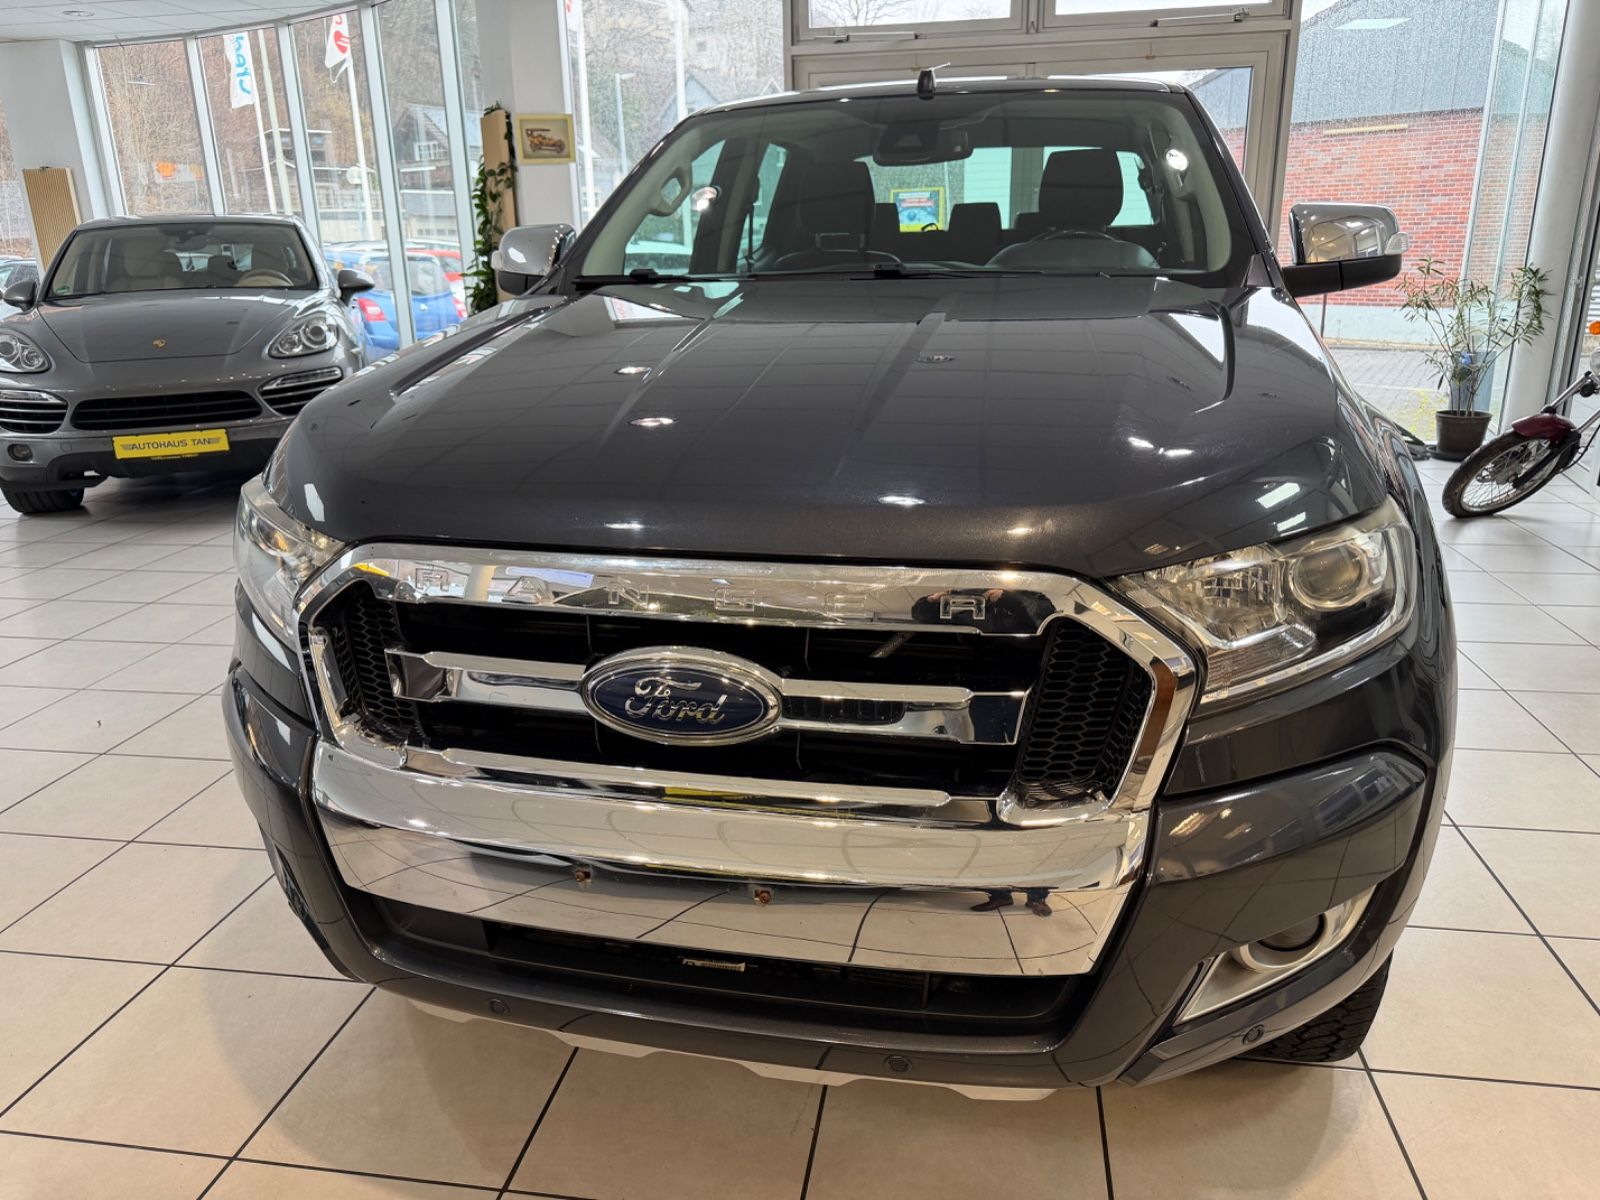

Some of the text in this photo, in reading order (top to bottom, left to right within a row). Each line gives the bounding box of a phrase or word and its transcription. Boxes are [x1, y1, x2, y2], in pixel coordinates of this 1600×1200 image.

[131, 437, 210, 451] AUTOHAUS TAN
[414, 566, 986, 621] RANGER
[624, 675, 728, 725] Ford
